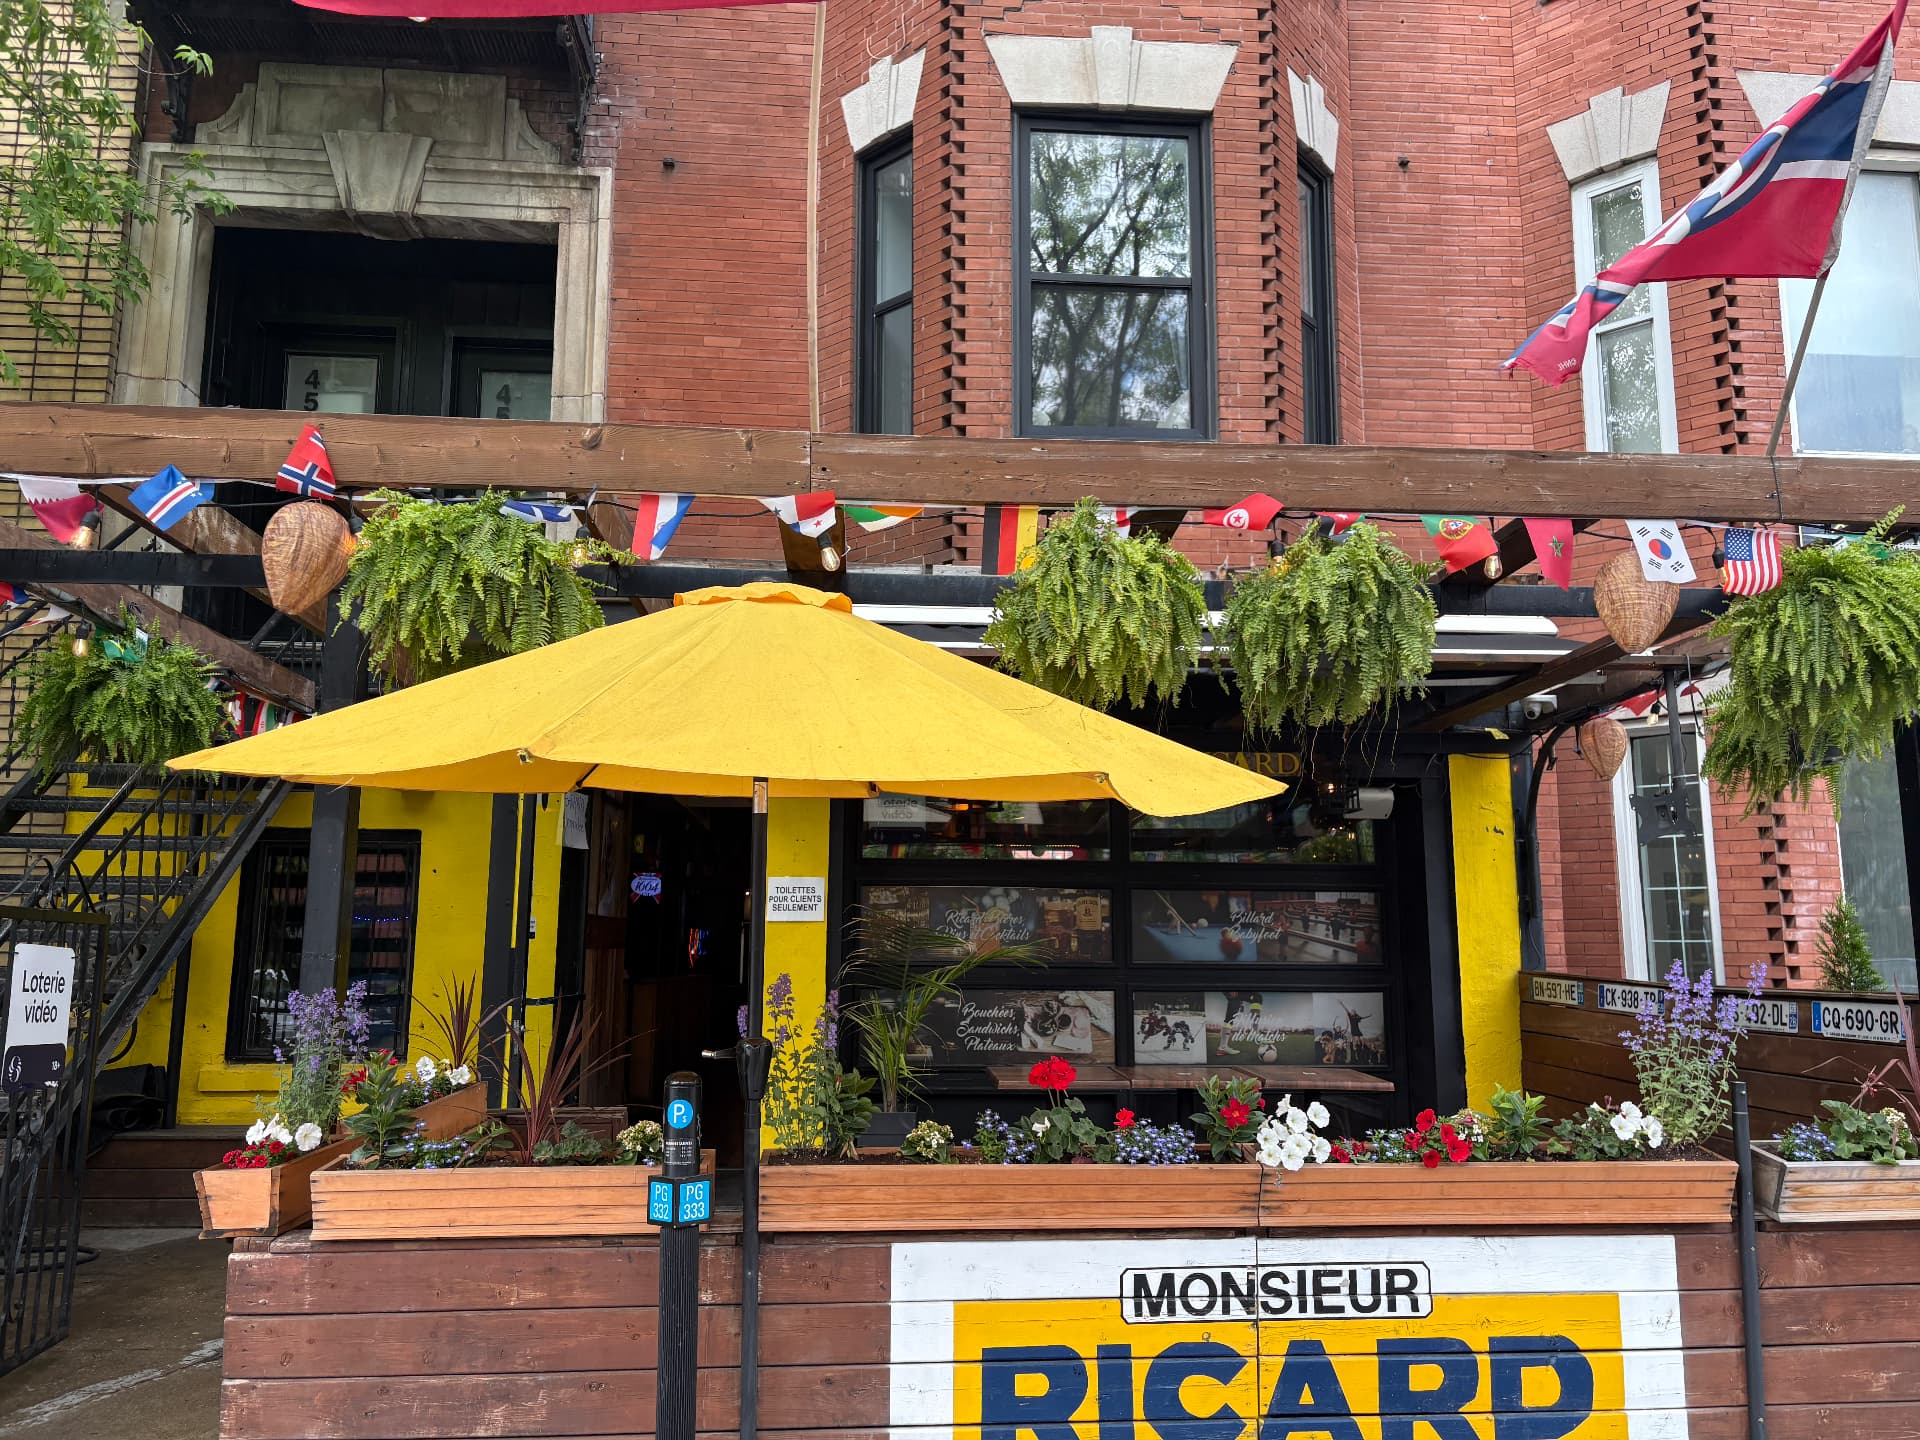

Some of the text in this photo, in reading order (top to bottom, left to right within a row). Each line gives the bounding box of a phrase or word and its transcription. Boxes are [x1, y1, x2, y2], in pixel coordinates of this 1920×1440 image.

[768, 895, 822, 903] POUR CLIENTS
[775, 886, 816, 894] TOILETTES
[772, 903, 818, 912] SEULEMENT
[22, 969, 66, 994] Loterie
[25, 999, 58, 1024] vidéo
[964, 1035, 1017, 1052] Plateaux
[655, 1184, 669, 1202] PG
[686, 1183, 704, 1201] PG
[653, 1203, 669, 1219] 332
[683, 1201, 705, 1219] 333
[1133, 1267, 1421, 1318] MONSIEUR
[981, 1335, 1595, 1440] RICARD
